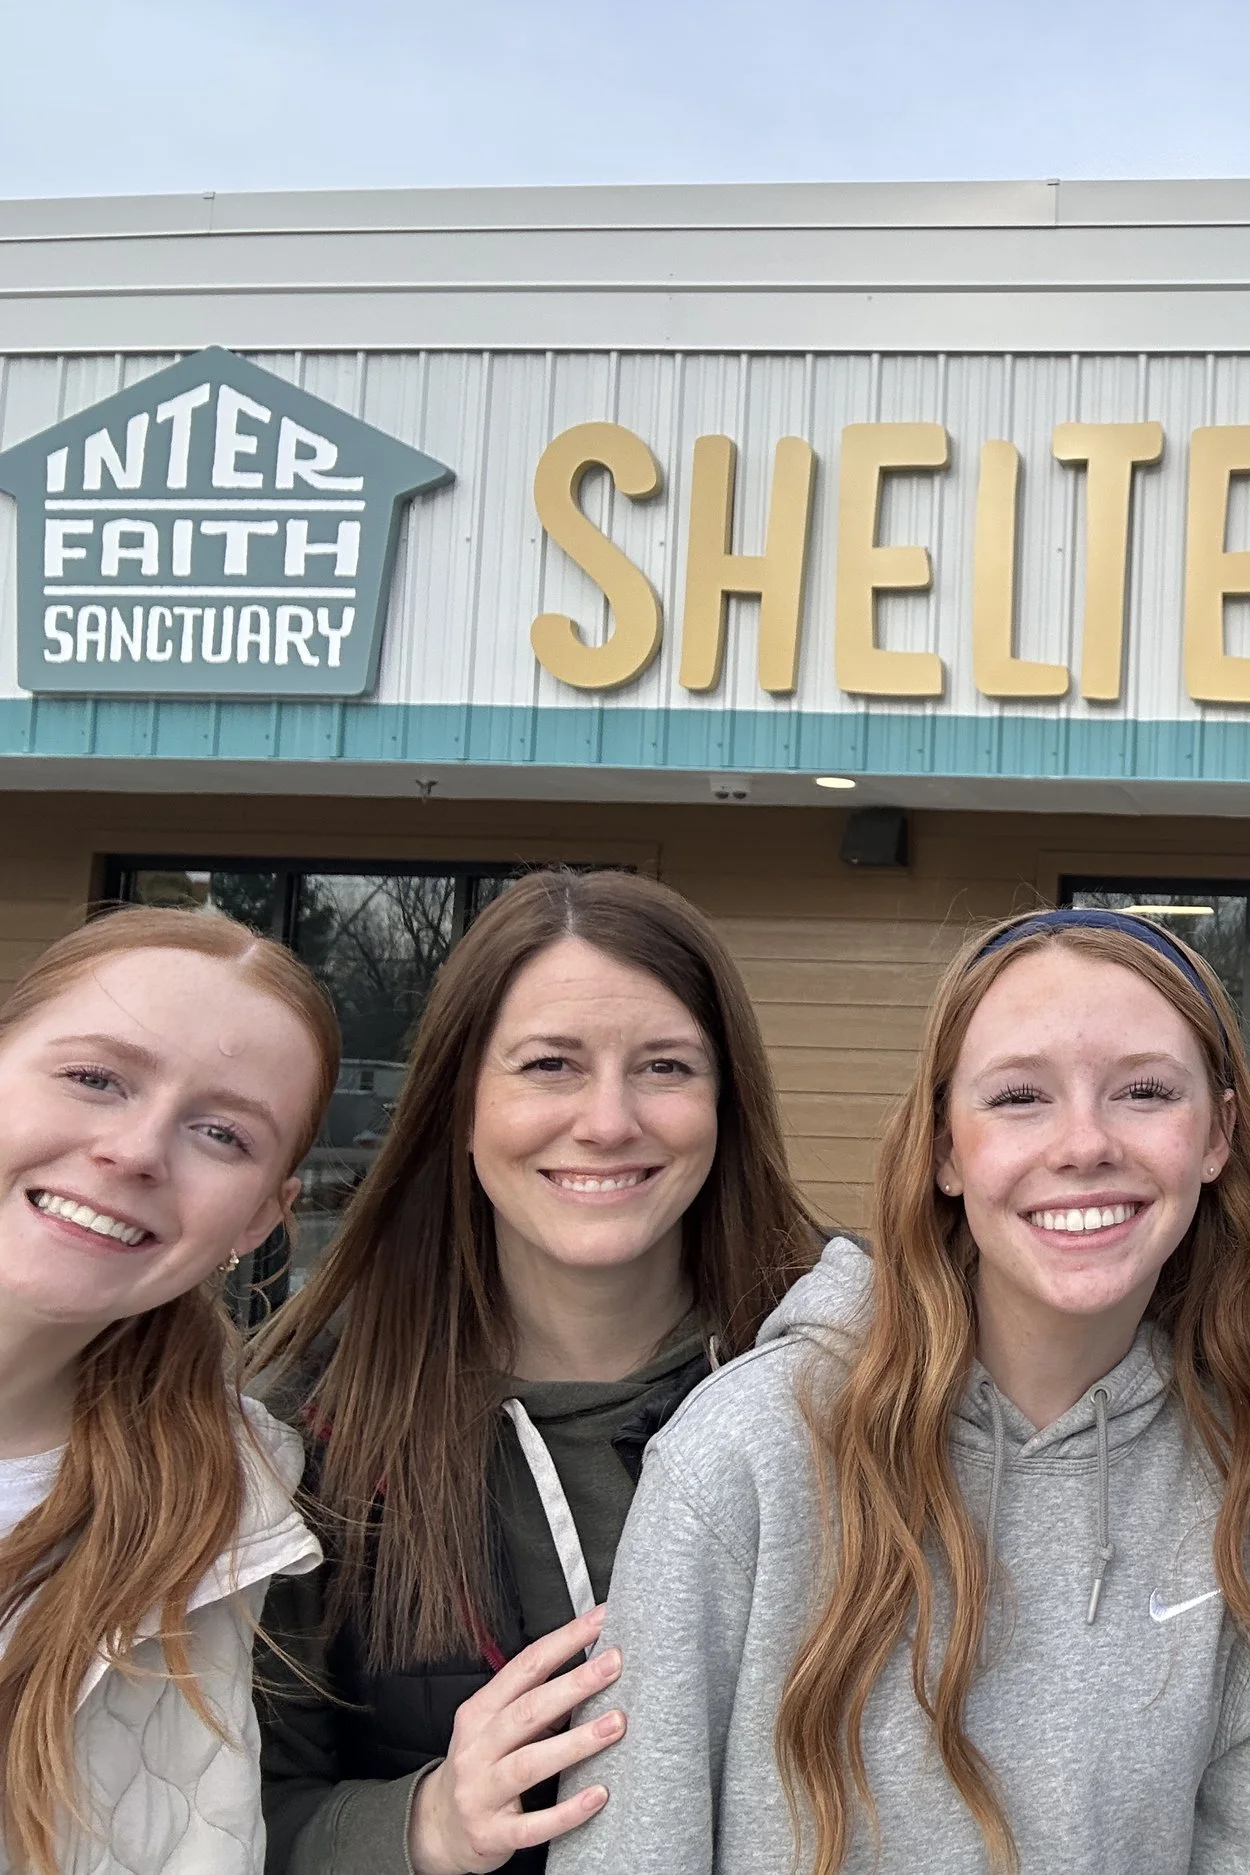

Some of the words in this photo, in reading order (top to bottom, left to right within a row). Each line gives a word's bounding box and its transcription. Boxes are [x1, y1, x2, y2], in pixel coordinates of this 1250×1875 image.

[46, 382, 364, 493] INTER
[44, 518, 361, 578] FAITH
[43, 604, 356, 668] SANCTUARY
